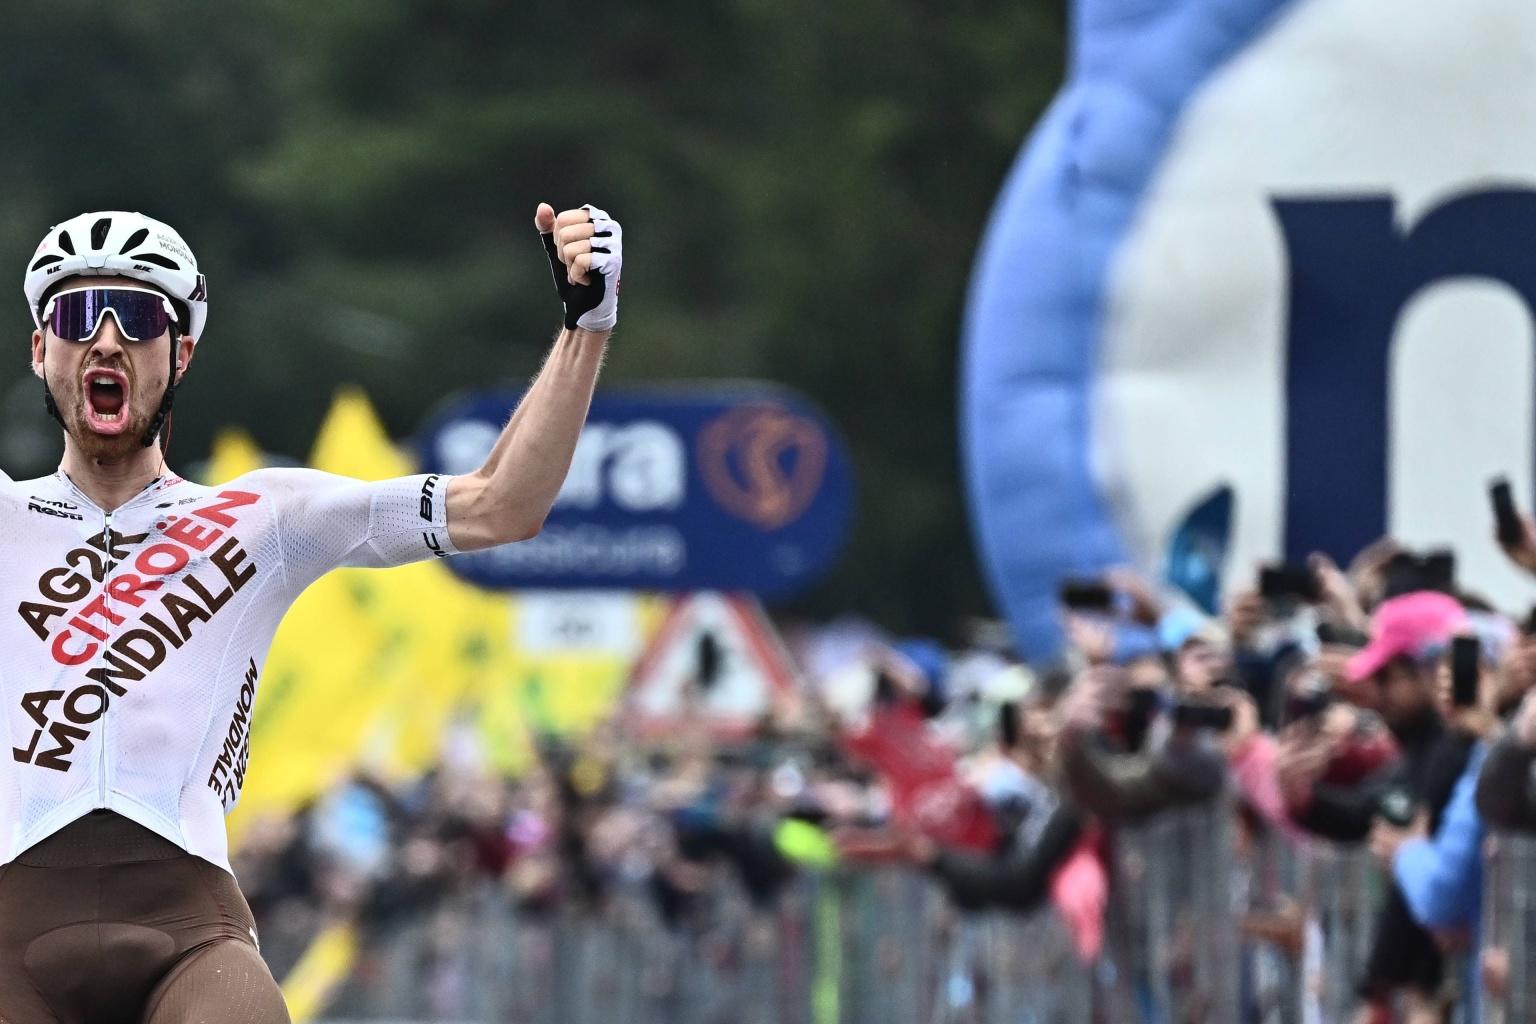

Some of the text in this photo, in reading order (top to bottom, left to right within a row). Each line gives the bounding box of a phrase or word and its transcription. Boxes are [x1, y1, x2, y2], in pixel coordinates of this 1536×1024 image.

[18, 527, 150, 642] AG2R
[51, 490, 262, 666] CITROËN
[34, 536, 257, 773] MONDIALE
[13, 689, 66, 764] LA
[207, 655, 259, 797] MONDIALE
